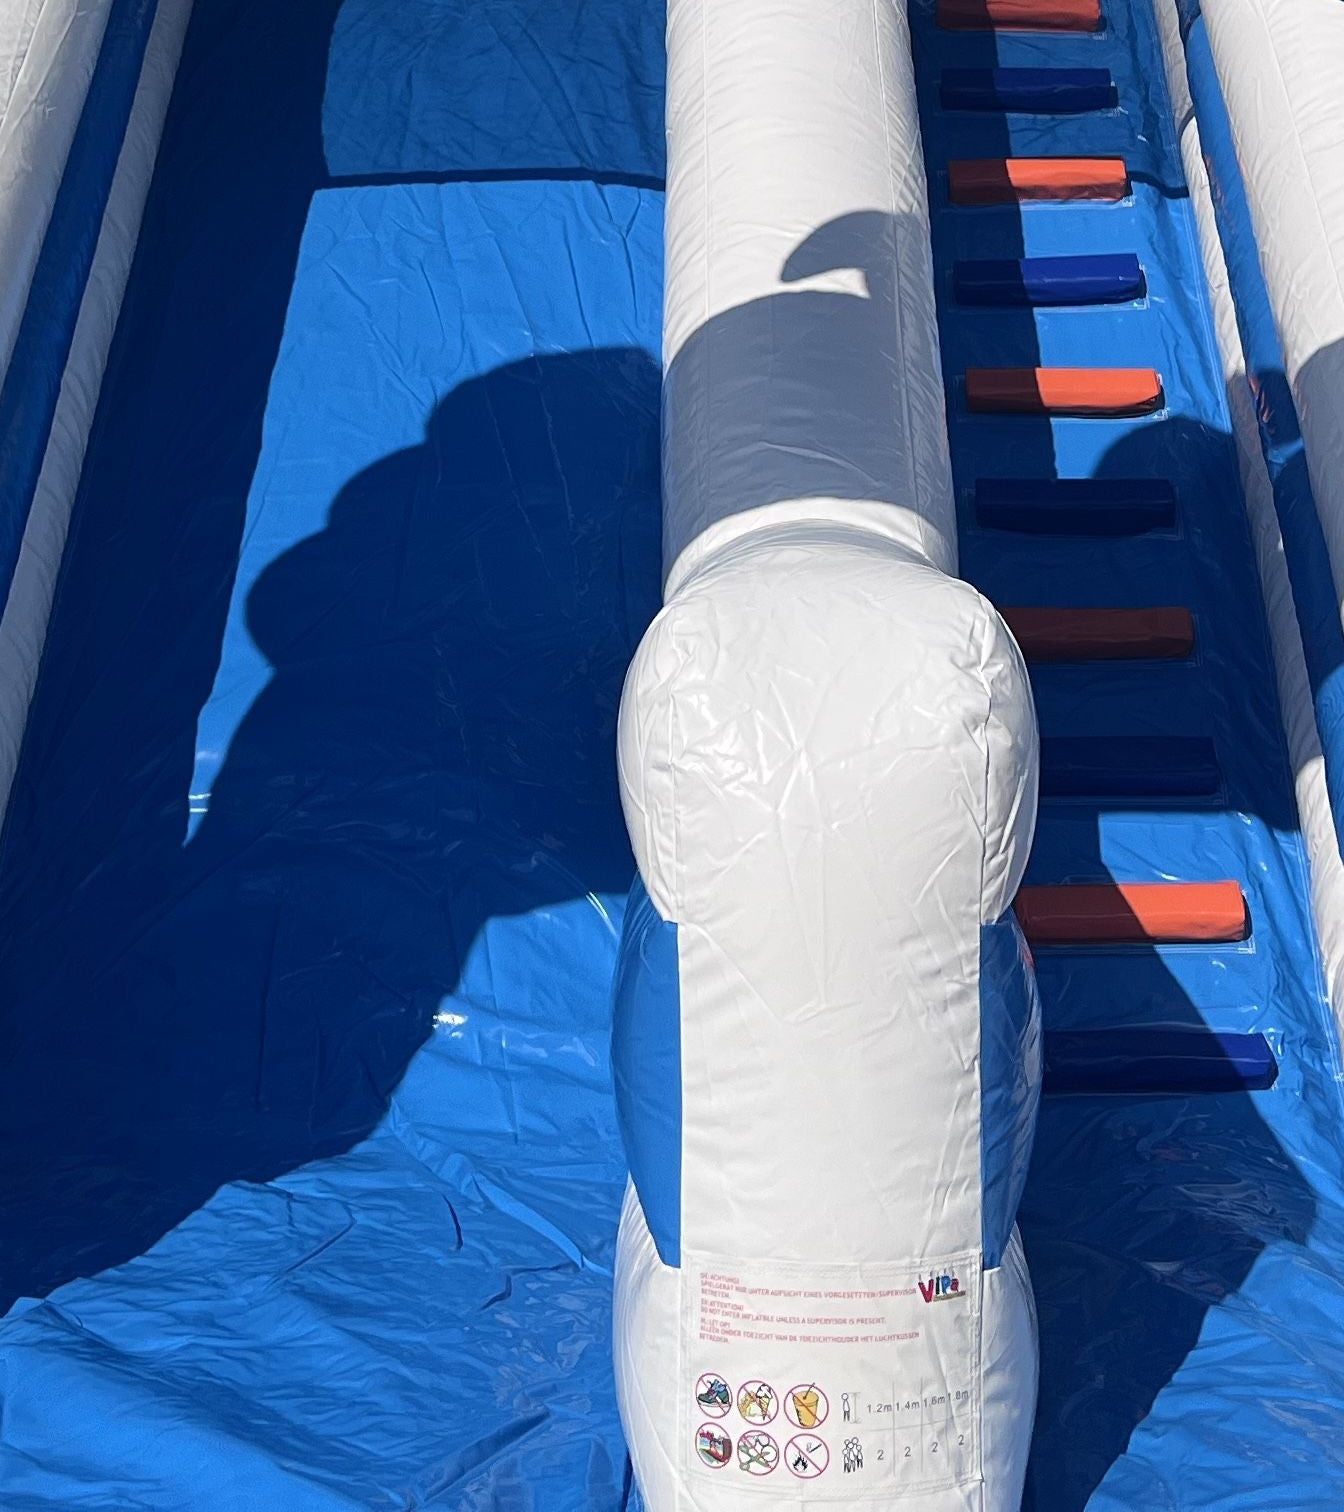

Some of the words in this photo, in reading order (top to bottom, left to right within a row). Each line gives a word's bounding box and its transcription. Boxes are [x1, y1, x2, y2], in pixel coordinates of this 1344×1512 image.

[770, 1289, 801, 1297] AUFSICHT
[721, 1310, 740, 1319] ENTER
[775, 1316, 800, 1324] UNLESS
[807, 1317, 847, 1325] SUPERVISOR
[720, 1328, 742, 1336] ONDER
[743, 1331, 774, 1340] TOEZICHT
[867, 1403, 893, 1414] 1.2m
[896, 1401, 920, 1411] 1.4m
[924, 1395, 946, 1408] 1.6m
[947, 1390, 969, 1401] 1.8m
[877, 1449, 885, 1461] 2
[904, 1446, 912, 1458] 2
[931, 1441, 939, 1453] 2
[958, 1434, 965, 1446] 2
